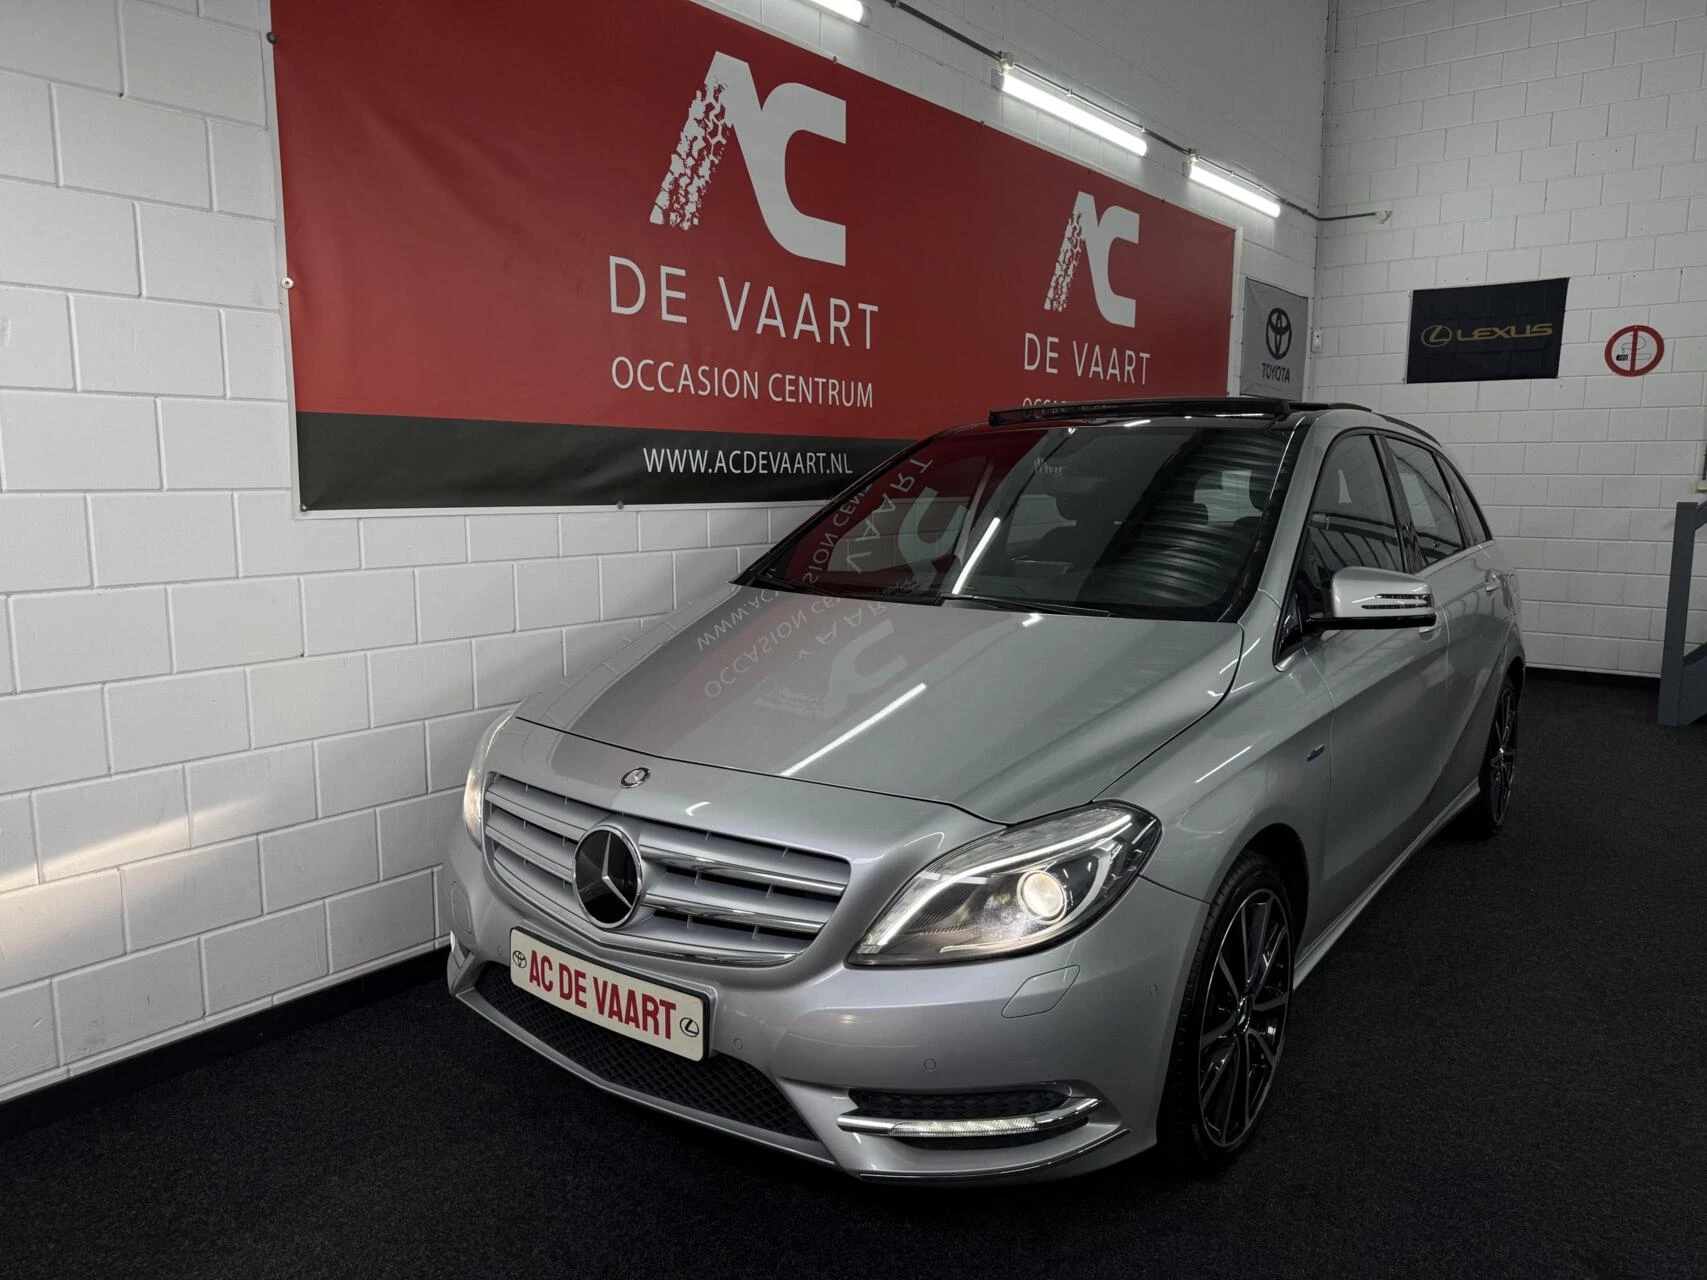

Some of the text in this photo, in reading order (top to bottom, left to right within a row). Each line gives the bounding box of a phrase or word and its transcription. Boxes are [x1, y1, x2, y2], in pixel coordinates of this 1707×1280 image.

[608, 255, 879, 350] DE VAART
[1456, 322, 1554, 342] LEXUS
[611, 356, 874, 409] OCCASION CENTRUM
[1023, 332, 1151, 386] DE VAART
[1261, 362, 1291, 384] TOYOTA
[643, 447, 854, 475] WWW.ACDEVAART.NL
[528, 949, 677, 1040] AC DE VAART
